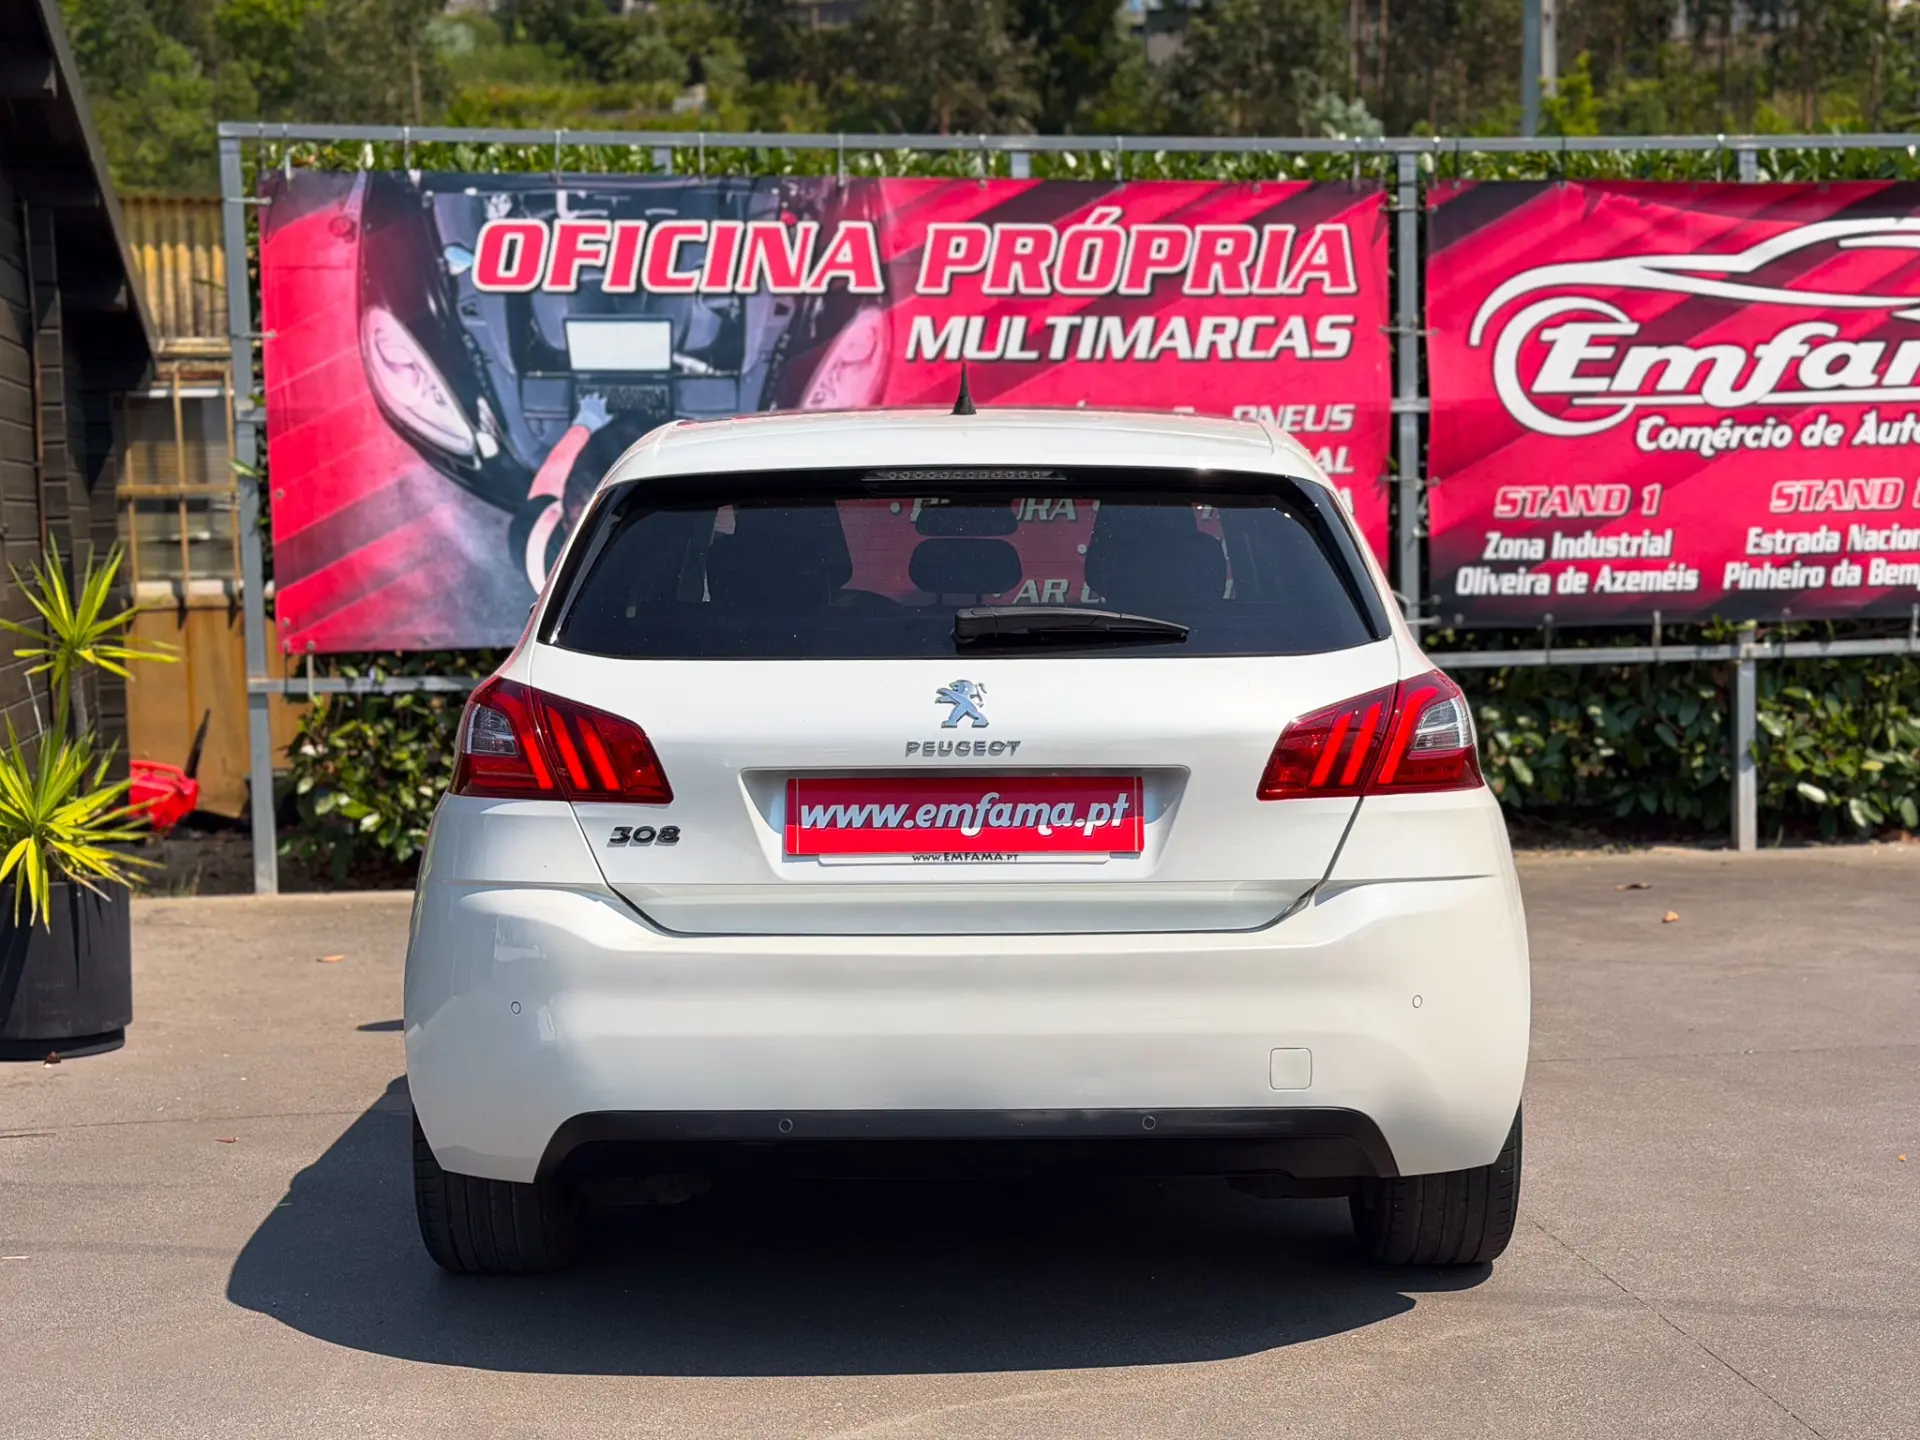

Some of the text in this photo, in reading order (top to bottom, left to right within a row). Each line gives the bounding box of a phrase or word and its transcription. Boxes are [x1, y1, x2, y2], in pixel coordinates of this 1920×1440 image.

[472, 206, 1357, 297] OFICINA PRÓPRIA
[905, 314, 1355, 361] MULTIMARCAS
[1636, 414, 1793, 457] Comércio
[1800, 412, 1845, 449] de
[1493, 483, 1663, 518] STAND 1
[1769, 477, 1905, 513] STAND
[1482, 528, 1673, 560] Zona Industrial
[1745, 524, 1842, 555] Estrada
[1455, 562, 1700, 596] Oliveira de Azeméis
[1722, 557, 1920, 592] Pinheiro da Bem
[905, 740, 1021, 757] PEUGEOT
[800, 792, 1130, 837] www.emfama.pt
[606, 825, 681, 848] 308
